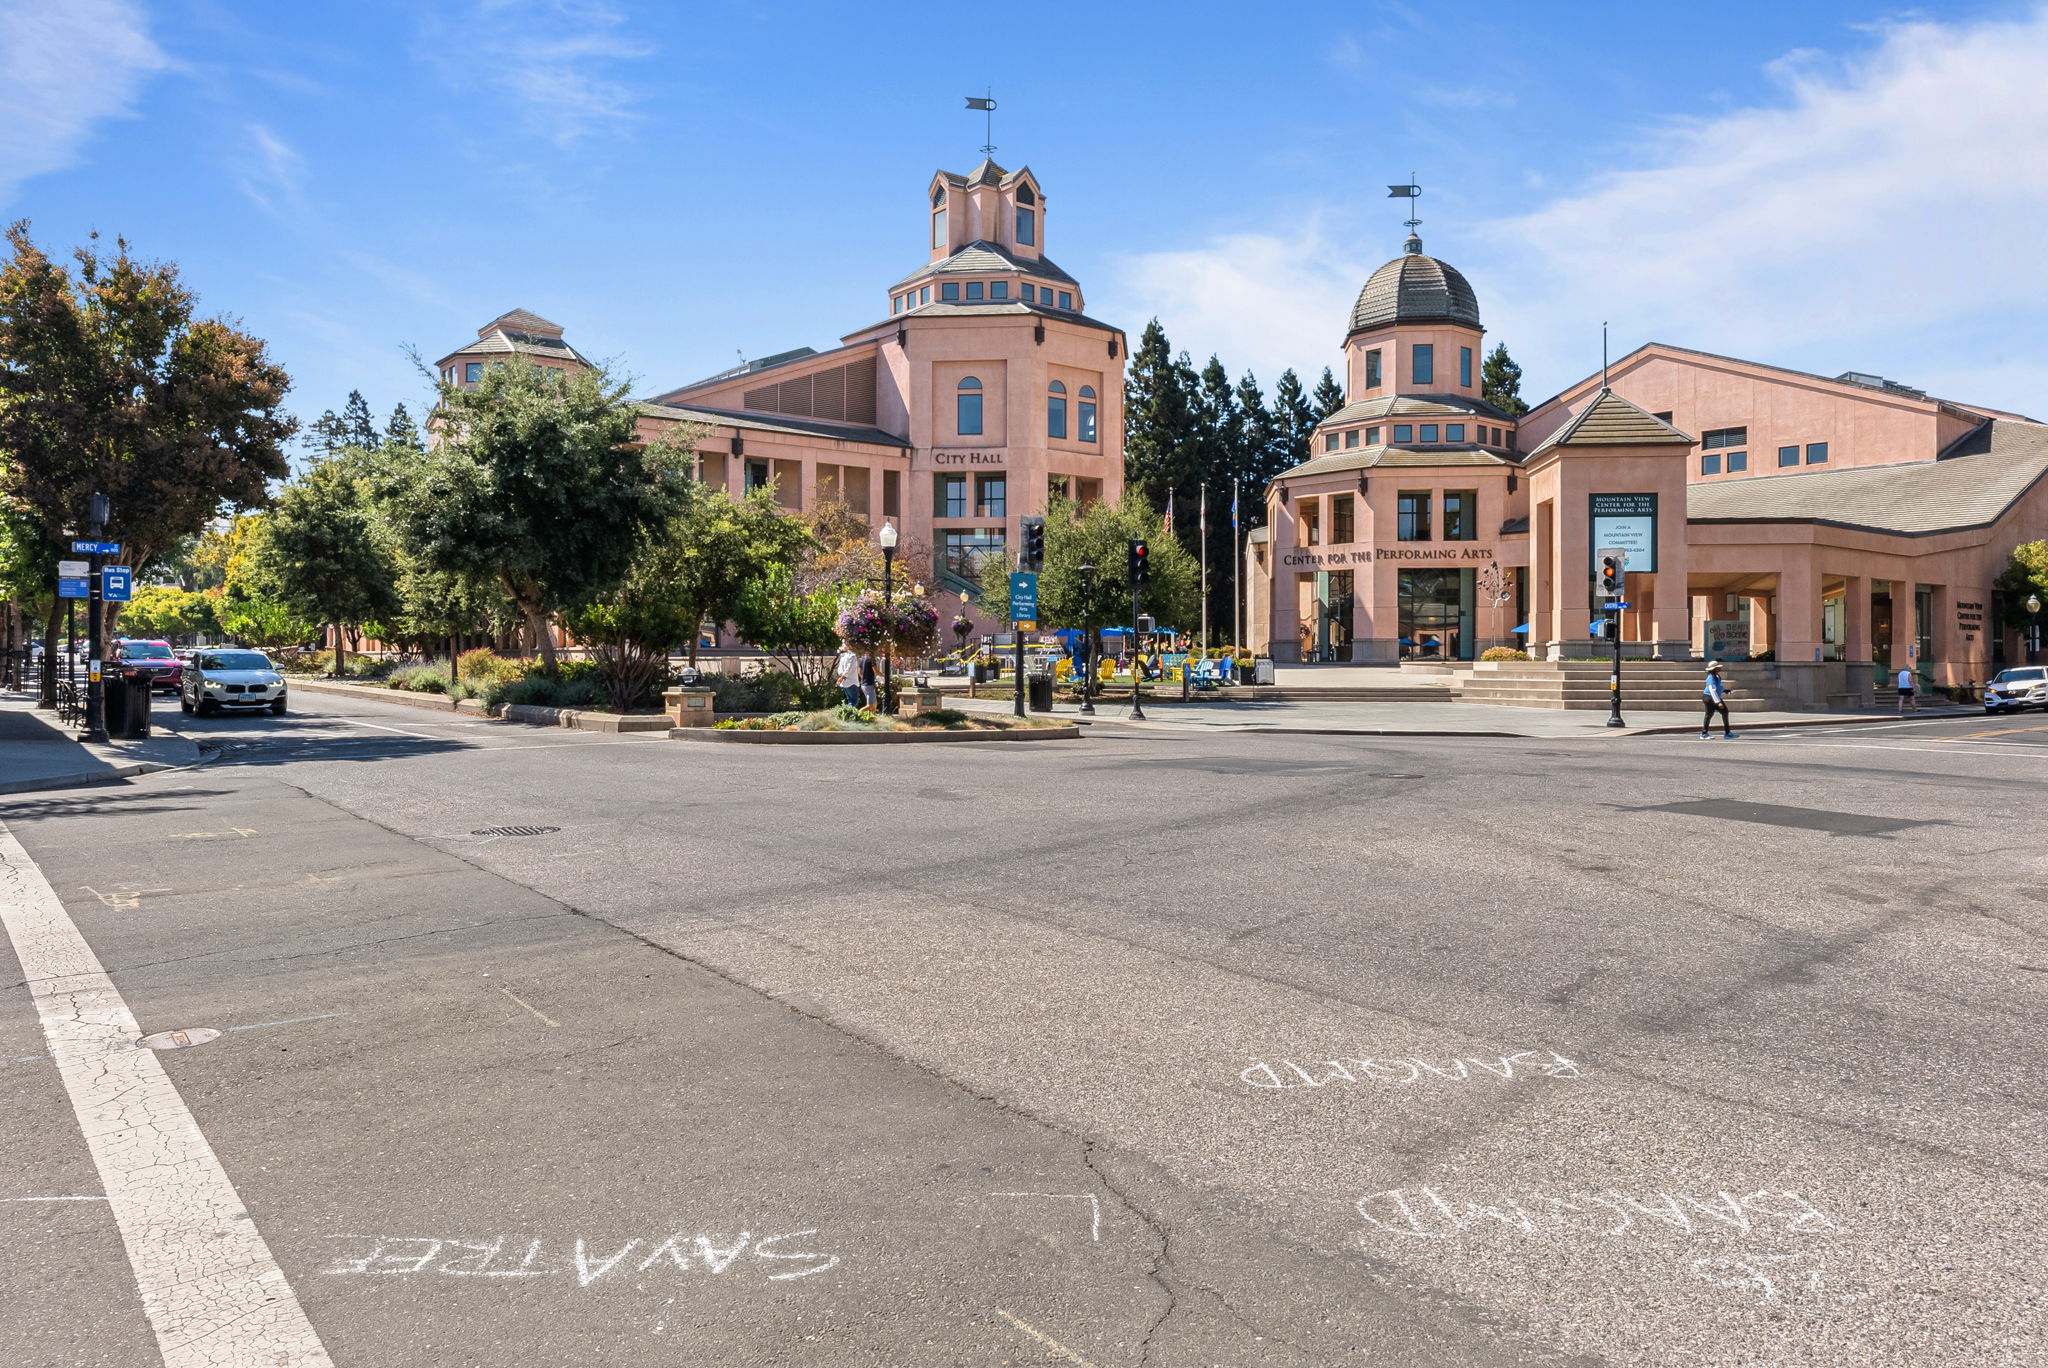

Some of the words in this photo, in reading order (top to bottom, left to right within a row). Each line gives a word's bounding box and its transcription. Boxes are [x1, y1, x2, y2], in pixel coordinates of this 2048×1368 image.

[935, 453, 966, 464] CITY
[970, 453, 1003, 464] HALL
[76, 543, 98, 551] MERCY
[1284, 553, 1323, 566] CENTER
[1327, 553, 1348, 565] FOR
[1350, 551, 1372, 563] THE
[1376, 549, 1457, 560] PERFORMING
[1460, 548, 1493, 560] ARTS
[1012, 621, 1018, 630] P
